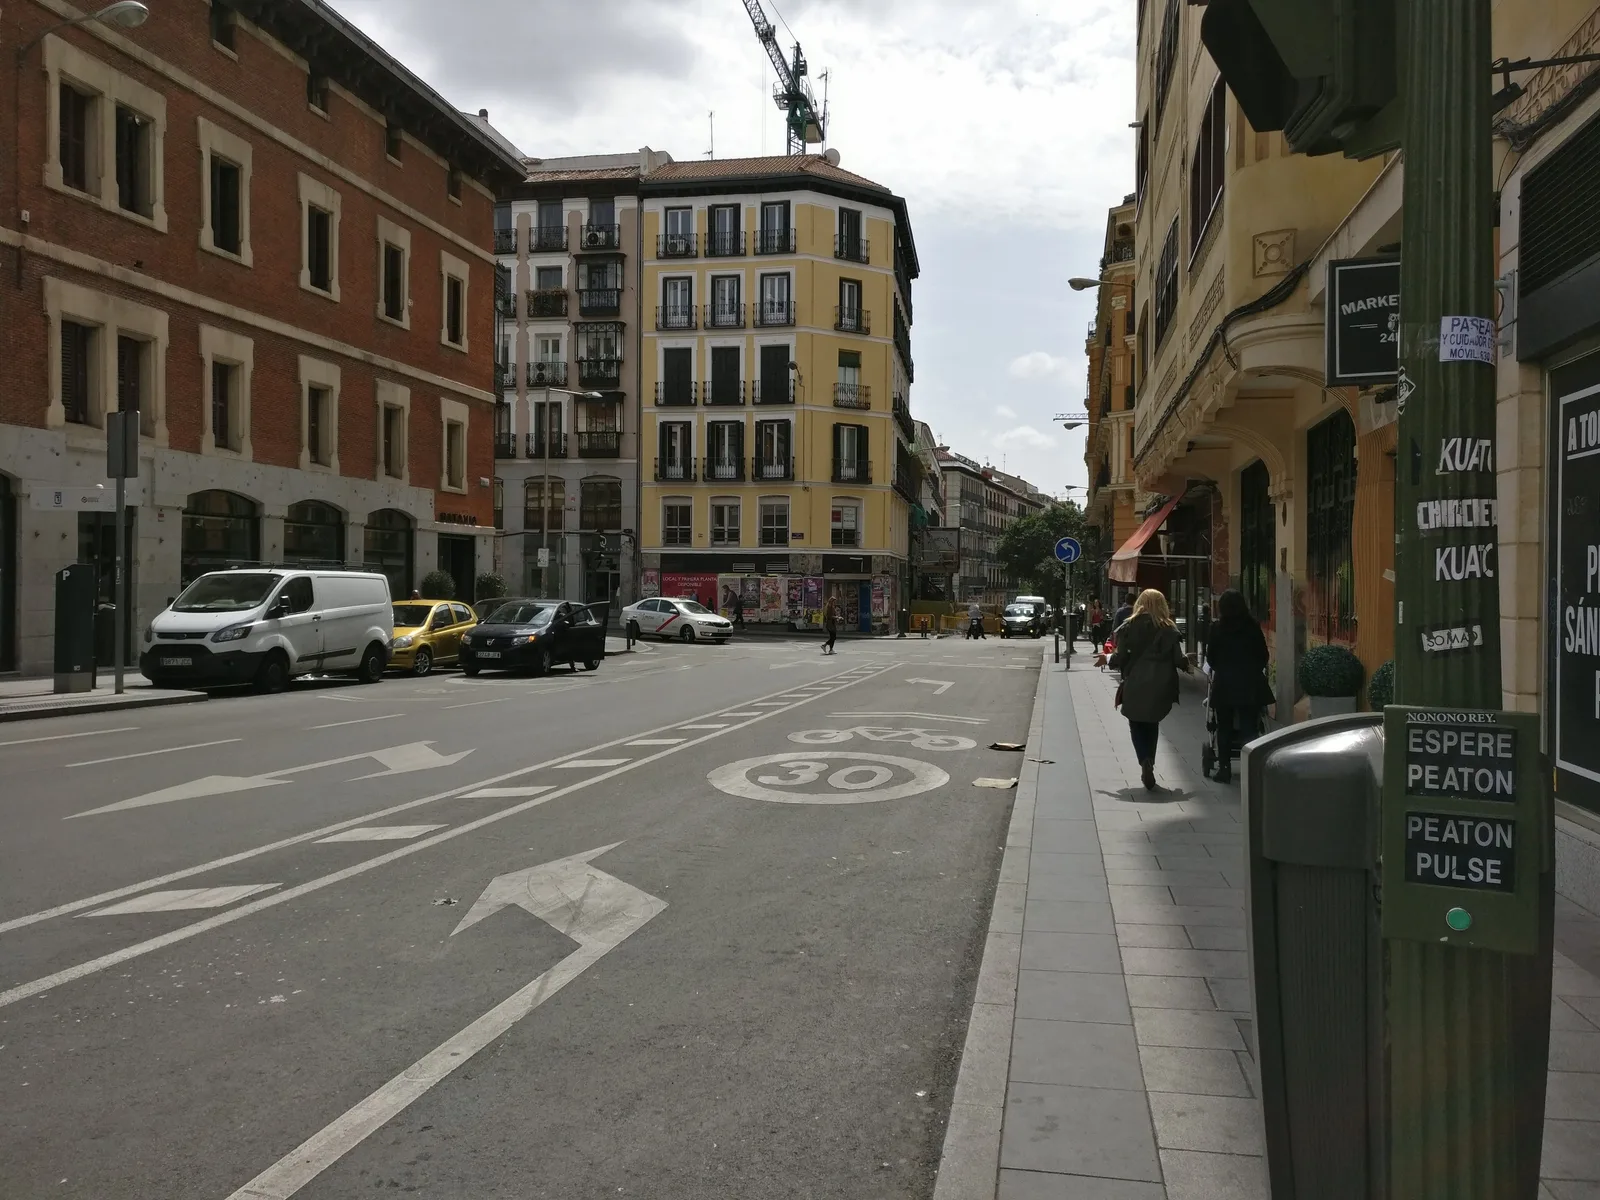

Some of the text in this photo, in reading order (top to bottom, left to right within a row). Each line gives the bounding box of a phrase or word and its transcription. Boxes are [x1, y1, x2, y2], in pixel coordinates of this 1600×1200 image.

[1341, 295, 1399, 315] MARKE
[1442, 334, 1448, 344] Y
[1567, 410, 1600, 451] A TO
[62, 570, 70, 580] P
[1587, 545, 1600, 593] P
[1565, 597, 1600, 656] SÁN
[1408, 729, 1513, 758] ESPERE
[757, 761, 893, 789] 30
[1407, 764, 1513, 795] PEATON
[1407, 816, 1512, 849] PEATON
[1416, 852, 1502, 885] PULSE
